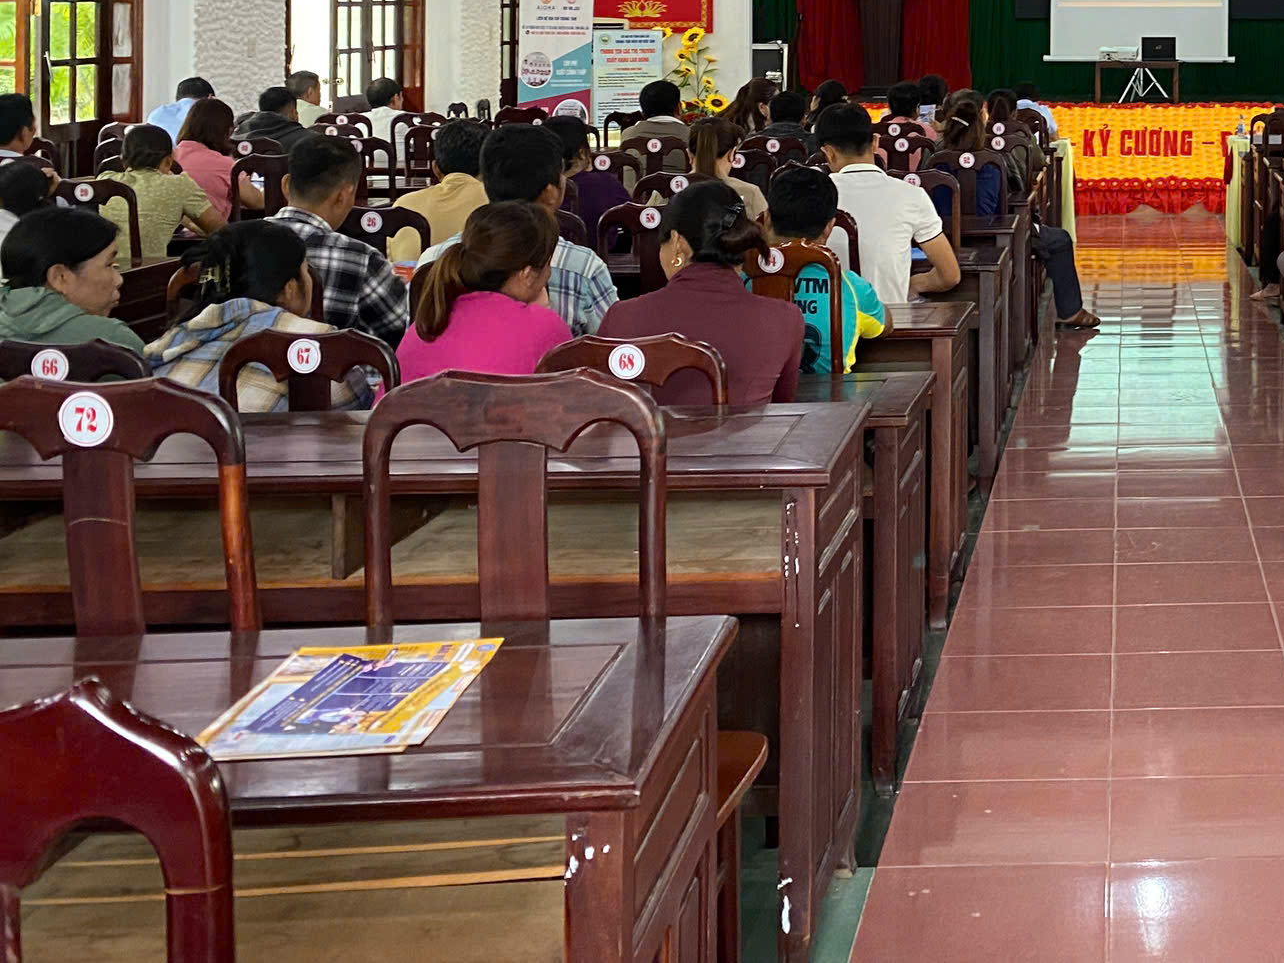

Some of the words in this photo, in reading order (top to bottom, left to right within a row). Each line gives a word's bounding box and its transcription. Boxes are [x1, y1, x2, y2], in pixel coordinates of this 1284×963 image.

[1082, 123, 1110, 157] KỶ
[1120, 125, 1192, 157] CƯƠNG
[297, 347, 312, 364] 67
[618, 353, 635, 370] 68
[41, 358, 60, 376] 66
[73, 407, 99, 433] 72
